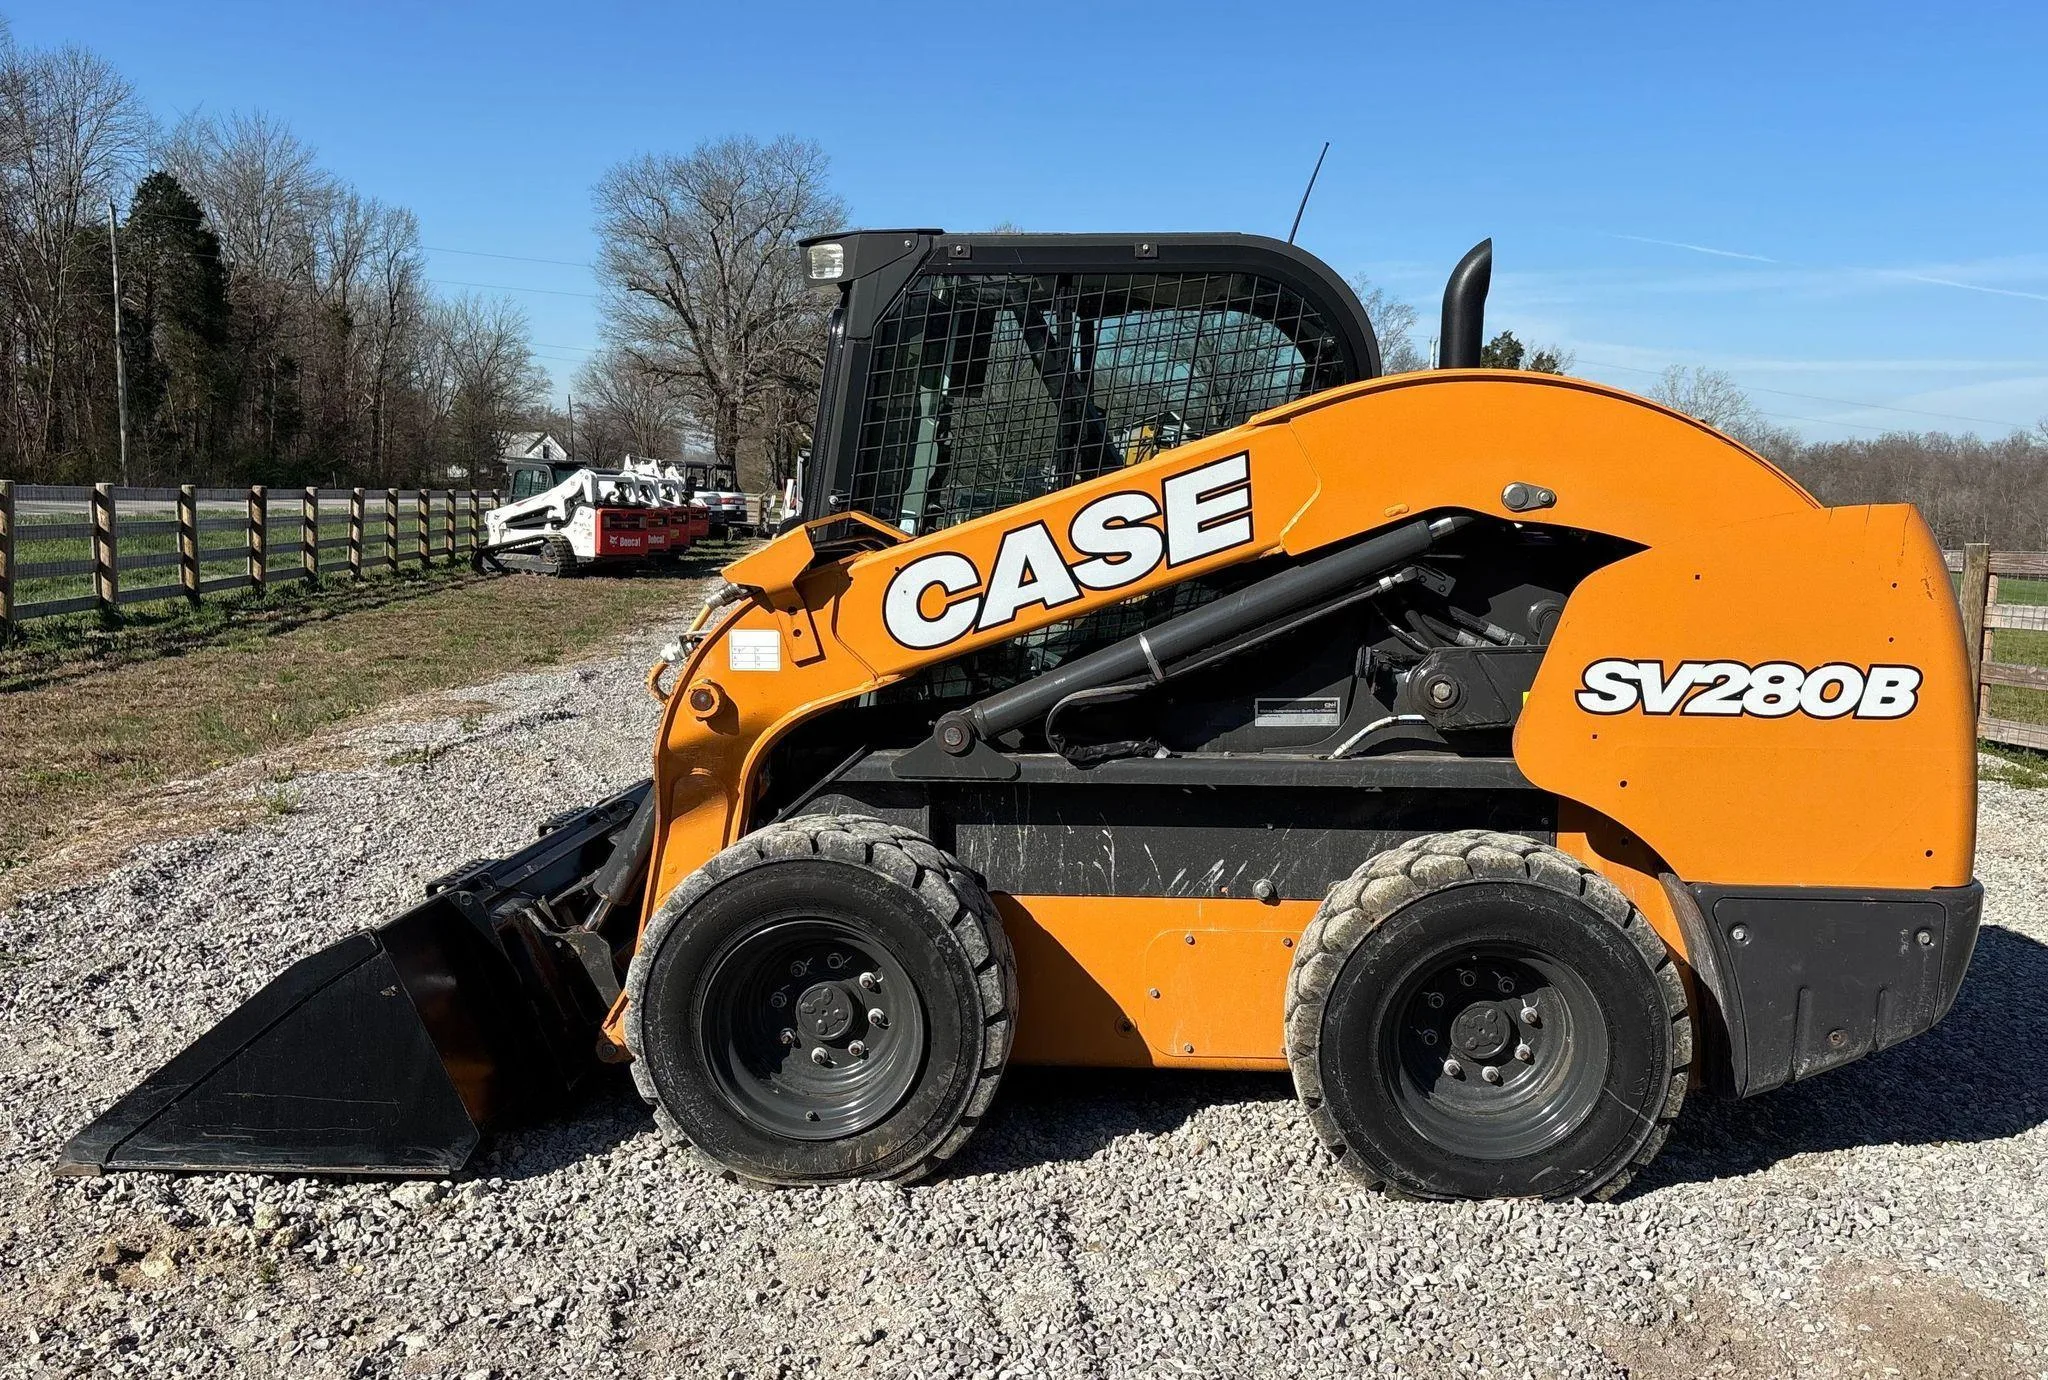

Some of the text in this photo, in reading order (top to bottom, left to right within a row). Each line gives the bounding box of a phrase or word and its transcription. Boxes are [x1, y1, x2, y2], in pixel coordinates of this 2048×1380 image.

[620, 536, 641, 547] Bobcat
[648, 535, 665, 544] Bobcat
[882, 449, 1254, 650] CASE
[1574, 657, 1924, 720] SV280B
